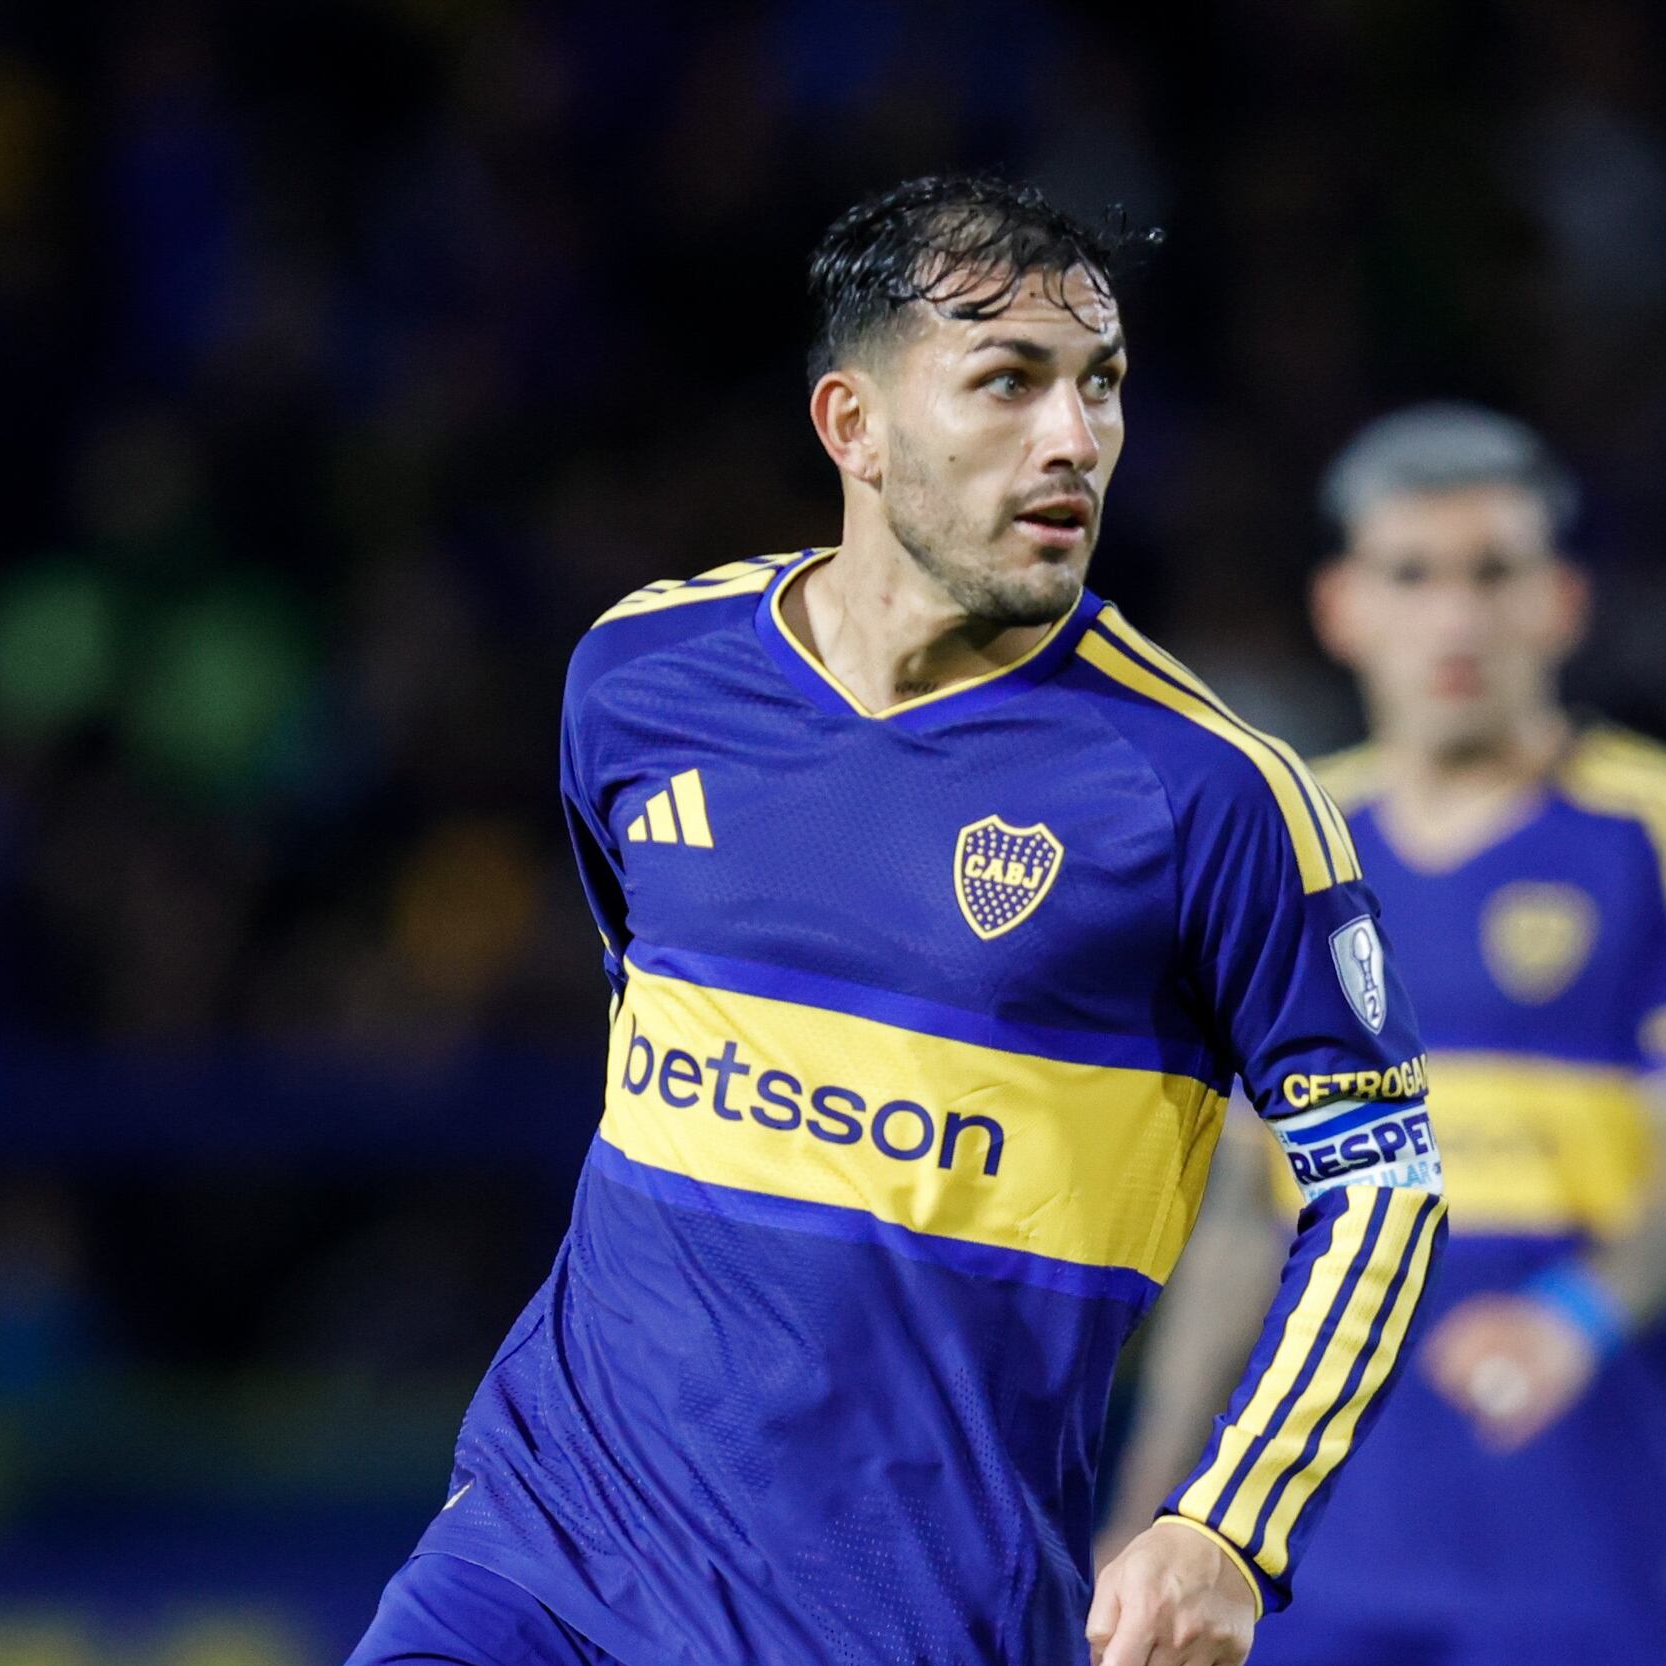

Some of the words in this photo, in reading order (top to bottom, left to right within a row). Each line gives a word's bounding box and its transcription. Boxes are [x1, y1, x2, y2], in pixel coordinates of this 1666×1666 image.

[964, 854, 1044, 889] CABJ
[621, 1012, 1006, 1178] betsson
[1283, 1053, 1428, 1108] CETROGA
